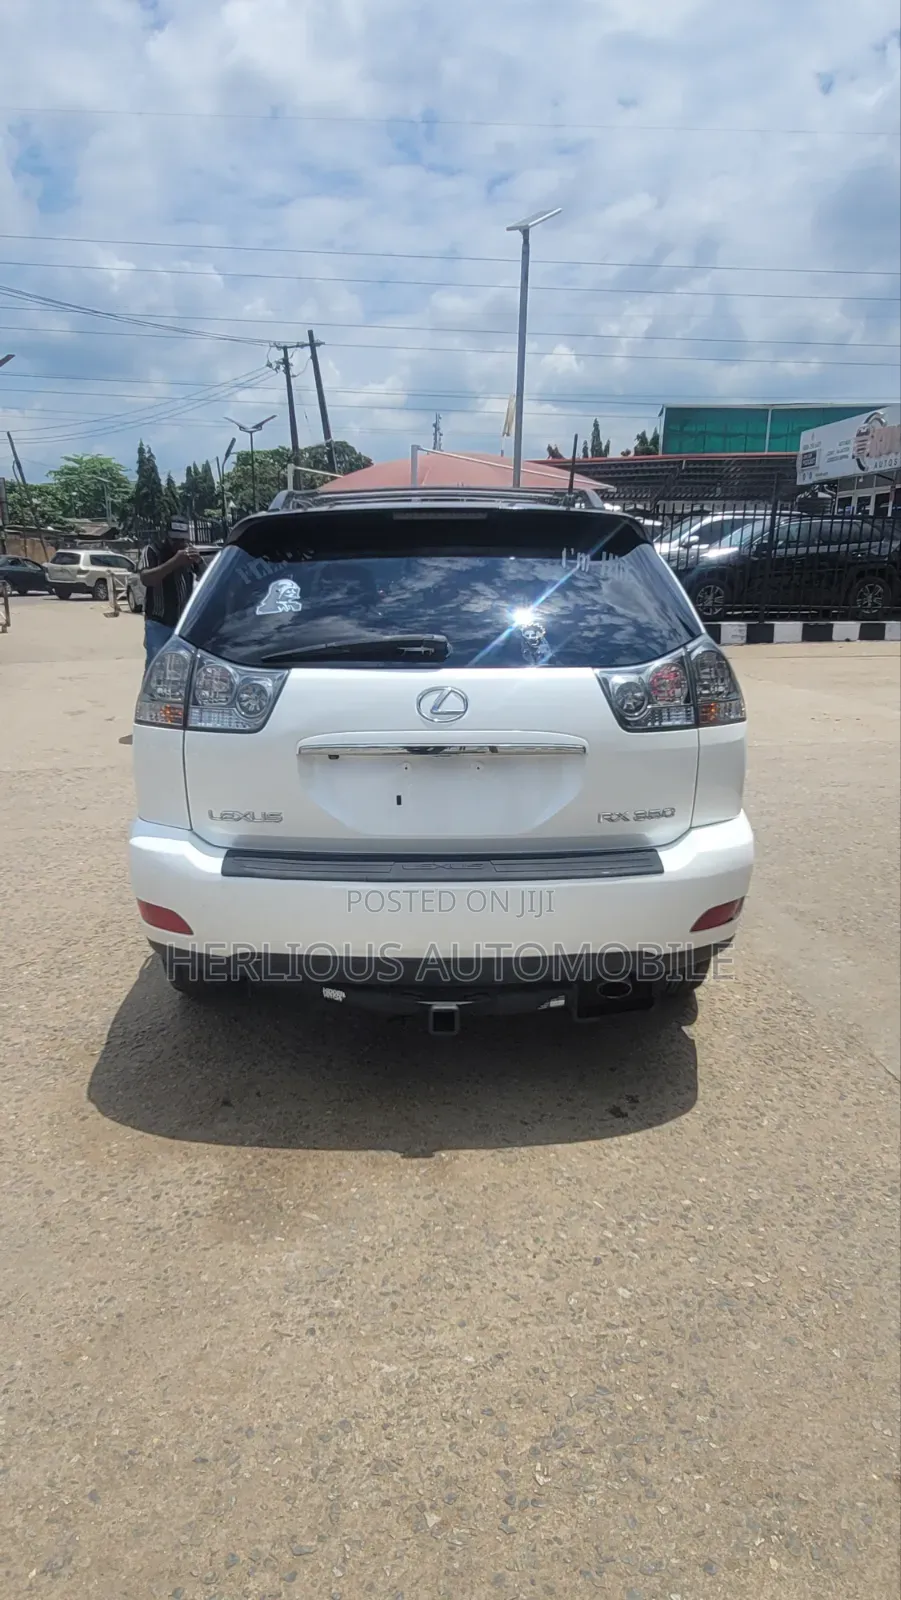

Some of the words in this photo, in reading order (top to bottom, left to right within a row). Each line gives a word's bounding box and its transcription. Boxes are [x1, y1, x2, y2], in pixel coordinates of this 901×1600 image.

[874, 458, 898, 469] AUTOS
[207, 809, 284, 823] LEXUS
[597, 810, 631, 824] RX
[632, 807, 676, 822] 350
